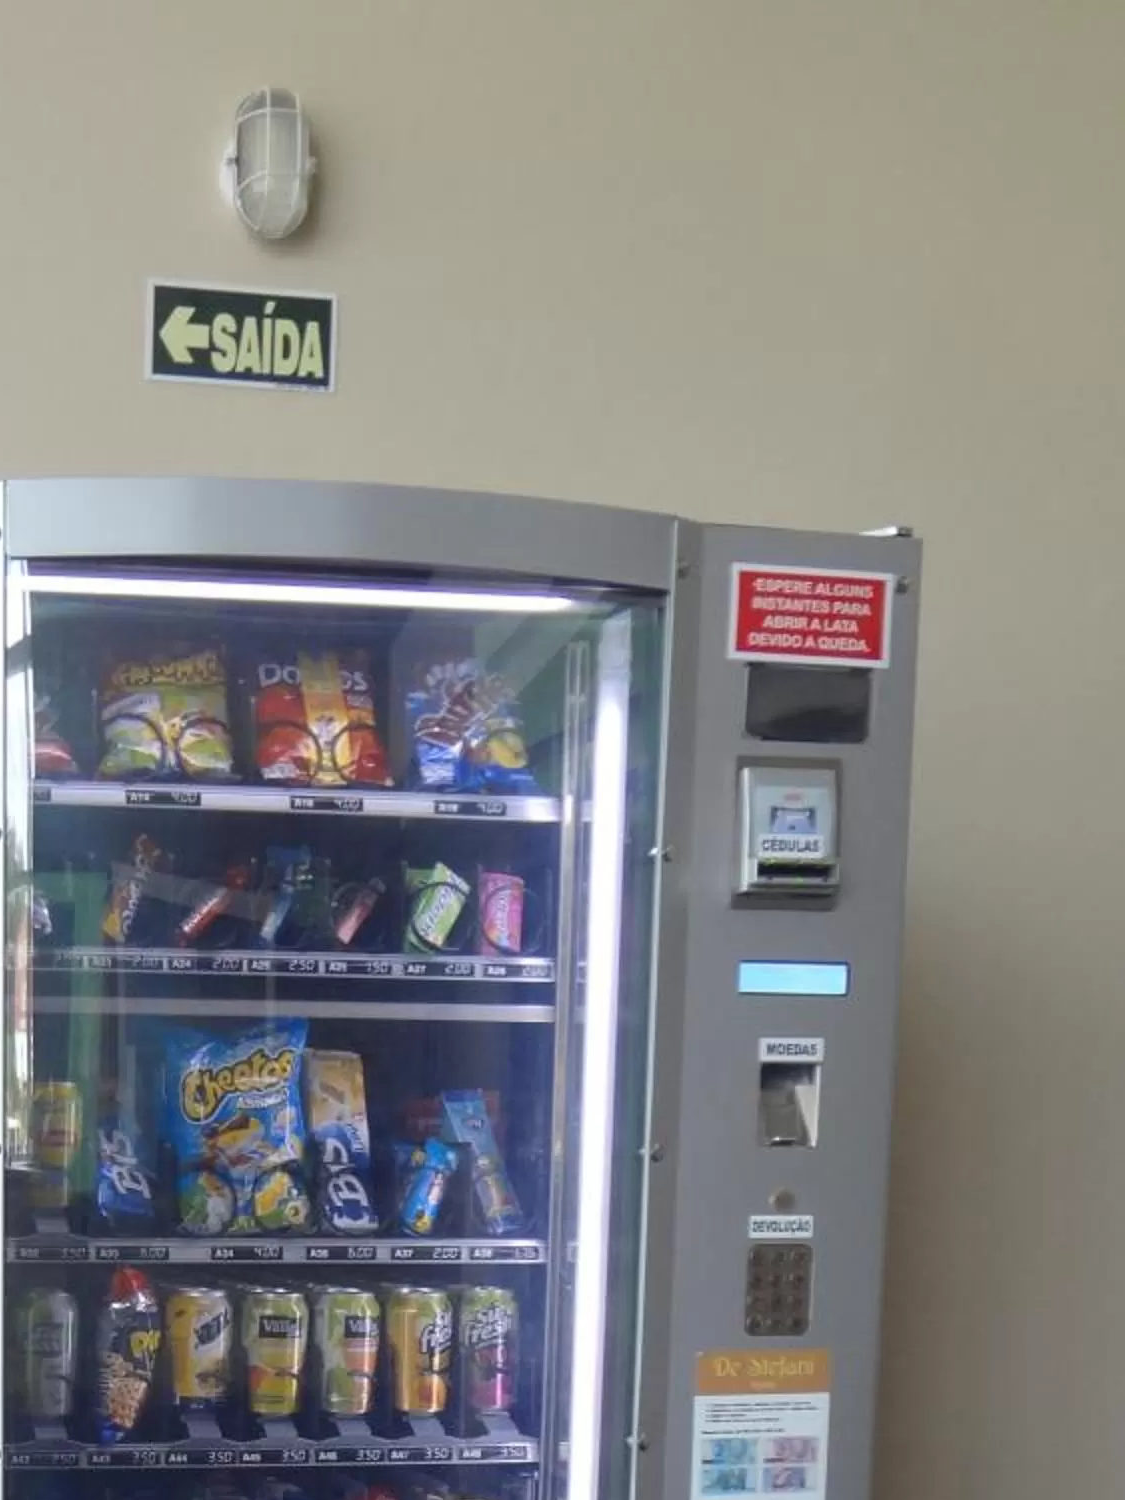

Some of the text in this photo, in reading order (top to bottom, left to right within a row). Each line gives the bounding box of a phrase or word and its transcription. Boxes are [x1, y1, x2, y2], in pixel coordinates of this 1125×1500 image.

[210, 301, 325, 379] SAÍDA
[752, 596, 872, 616] INSTANTES PARA
[763, 614, 859, 635] ABRIR A LATA
[749, 632, 802, 648] DEVIDO
[804, 636, 816, 648] A
[766, 1043, 818, 1056] MOEDAS
[183, 1049, 295, 1121] Cheetos
